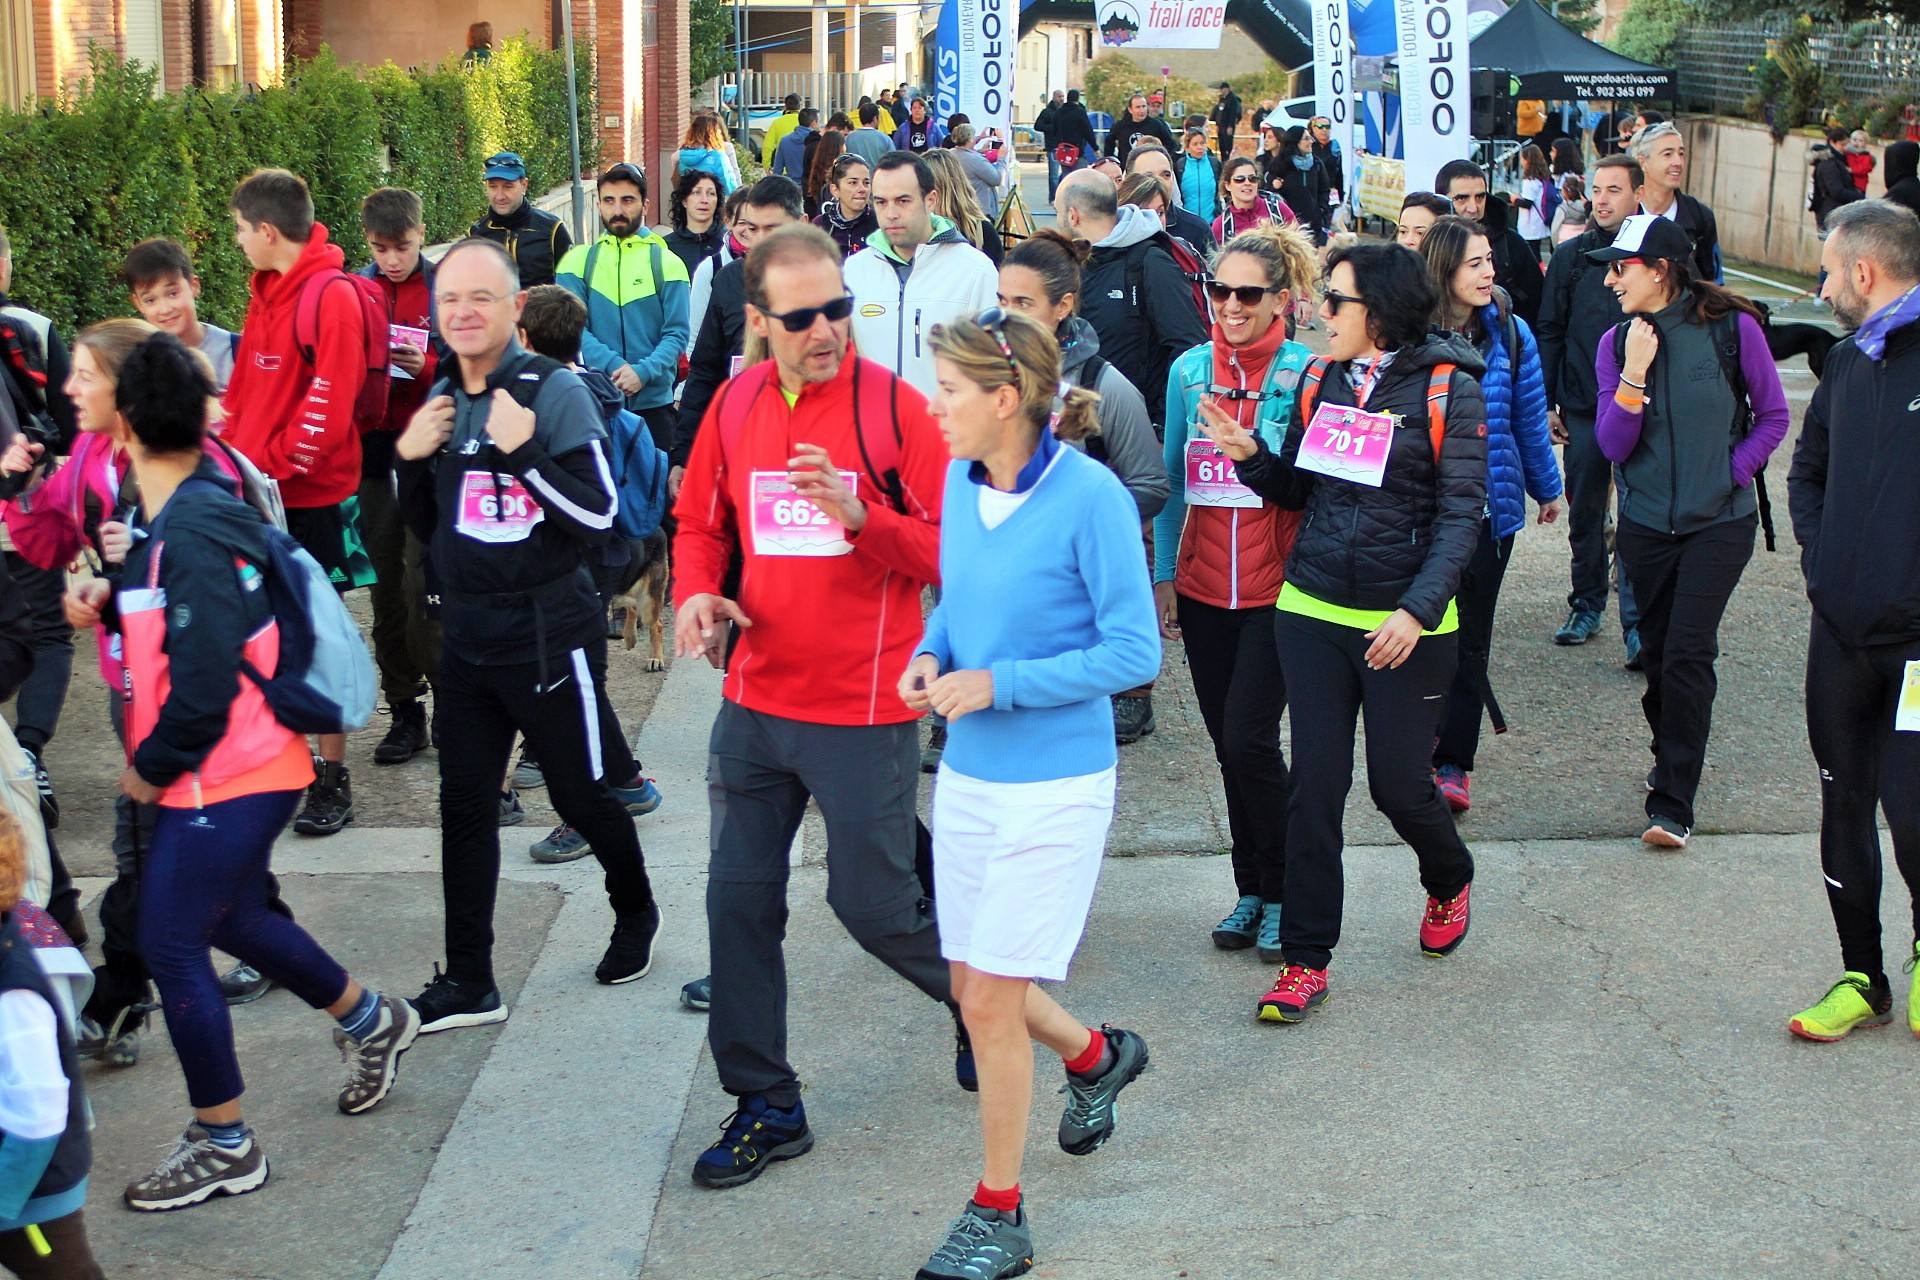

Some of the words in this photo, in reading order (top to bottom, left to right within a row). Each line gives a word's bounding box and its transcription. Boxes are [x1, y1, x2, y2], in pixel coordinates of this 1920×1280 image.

[1149, 2, 1183, 28] trail
[1186, 6, 1223, 28] race
[1563, 74, 1668, 85] www.podoactiva.com
[1576, 86, 1594, 97] Tel.
[1596, 86, 1615, 97] 902
[1616, 86, 1635, 97] 365
[1636, 86, 1655, 97] 099
[1323, 428, 1366, 456] 701
[773, 499, 832, 526] 662
